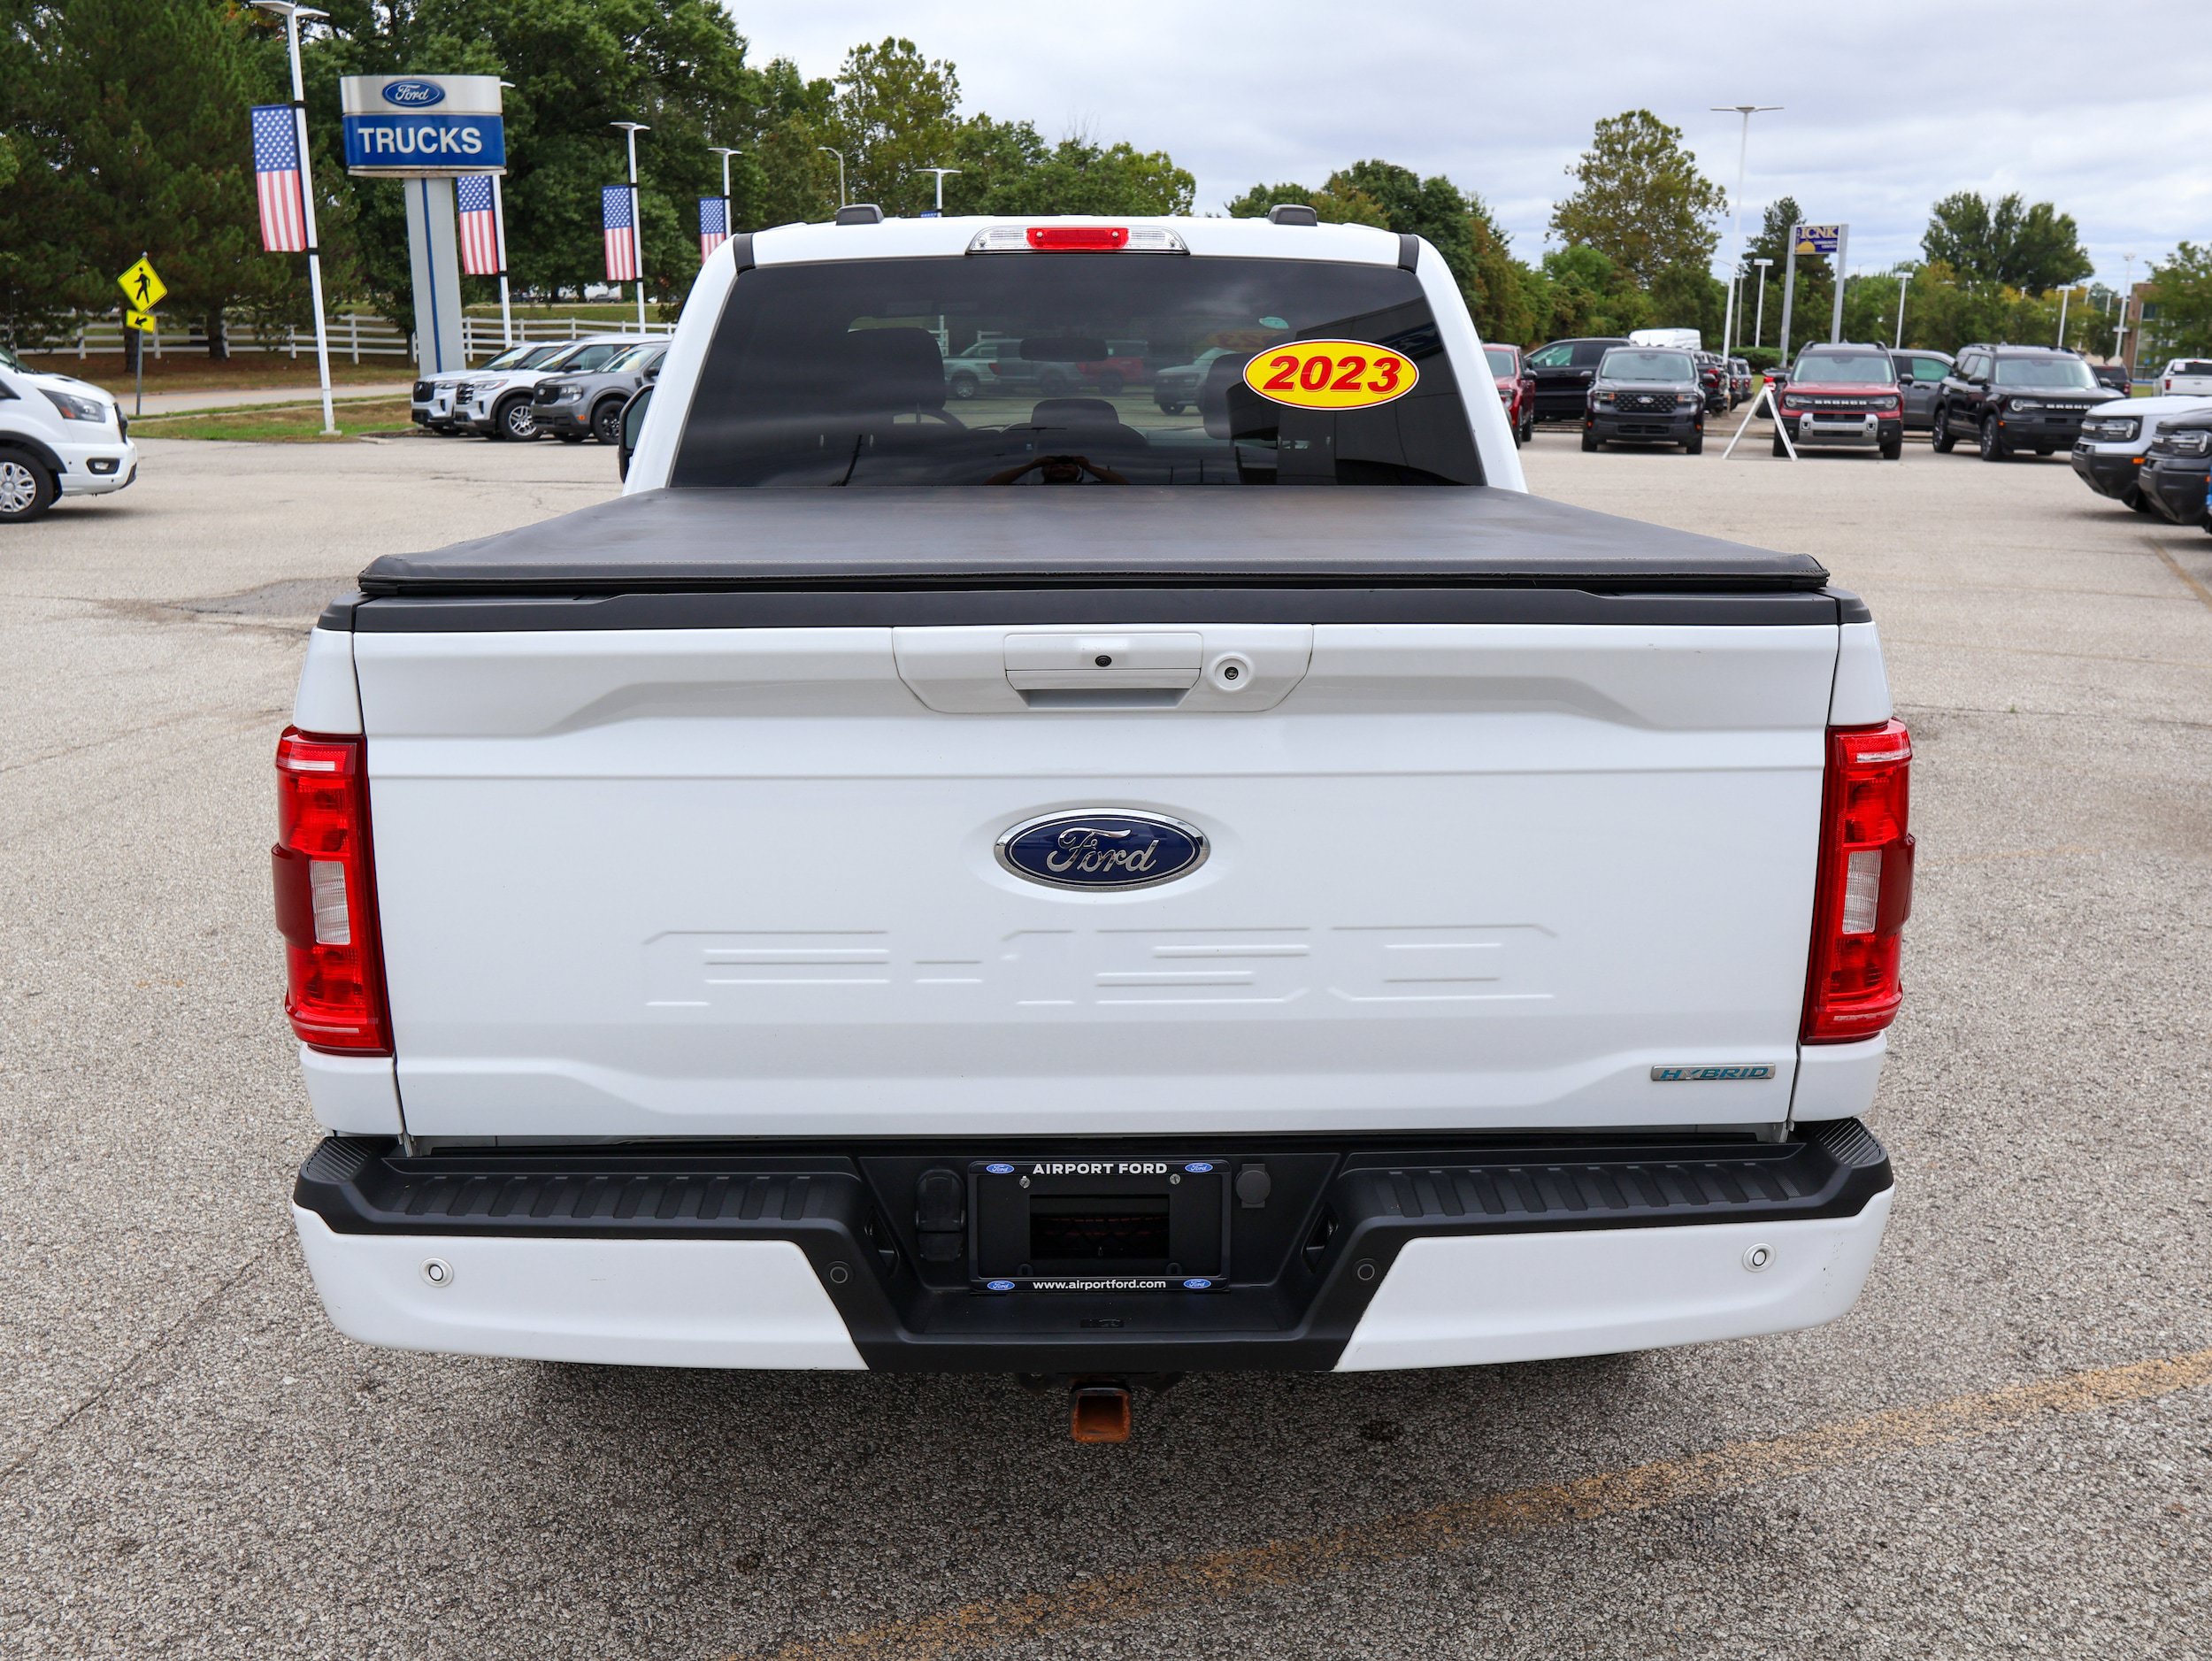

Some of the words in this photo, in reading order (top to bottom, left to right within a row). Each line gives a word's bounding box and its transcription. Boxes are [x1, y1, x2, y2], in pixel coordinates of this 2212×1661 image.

[396, 84, 429, 101] Ford
[357, 127, 483, 155] TRUCKS
[1263, 355, 1402, 395] 2023
[1046, 827, 1160, 873] Ford
[1660, 1067, 1770, 1080] HYBRID
[1033, 1163, 1114, 1175] AIRPORT
[1118, 1163, 1168, 1174] FORD
[1033, 1279, 1167, 1291] www.airportford.com
